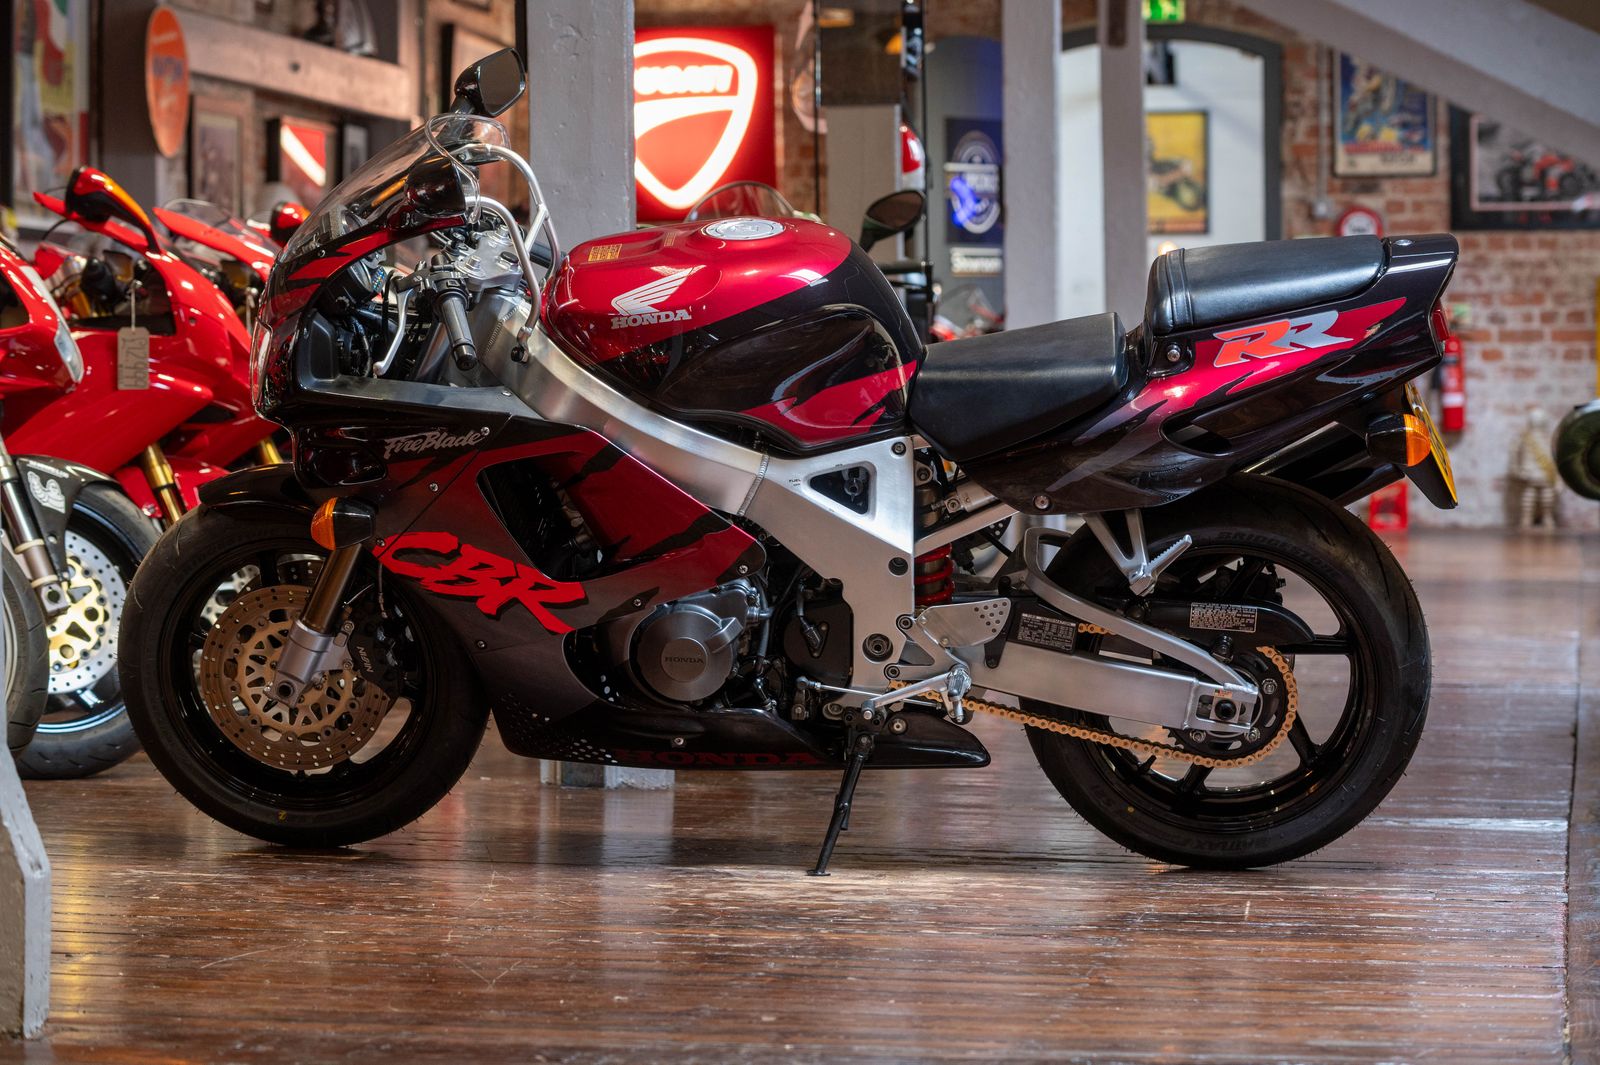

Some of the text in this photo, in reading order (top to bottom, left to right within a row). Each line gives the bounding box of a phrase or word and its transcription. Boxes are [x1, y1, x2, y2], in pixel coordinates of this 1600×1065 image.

[611, 309, 692, 330] HONDA
[1213, 310, 1355, 368] RR
[372, 531, 586, 635] CBR
[663, 656, 705, 664] HONDA
[614, 749, 824, 767] HONDA
